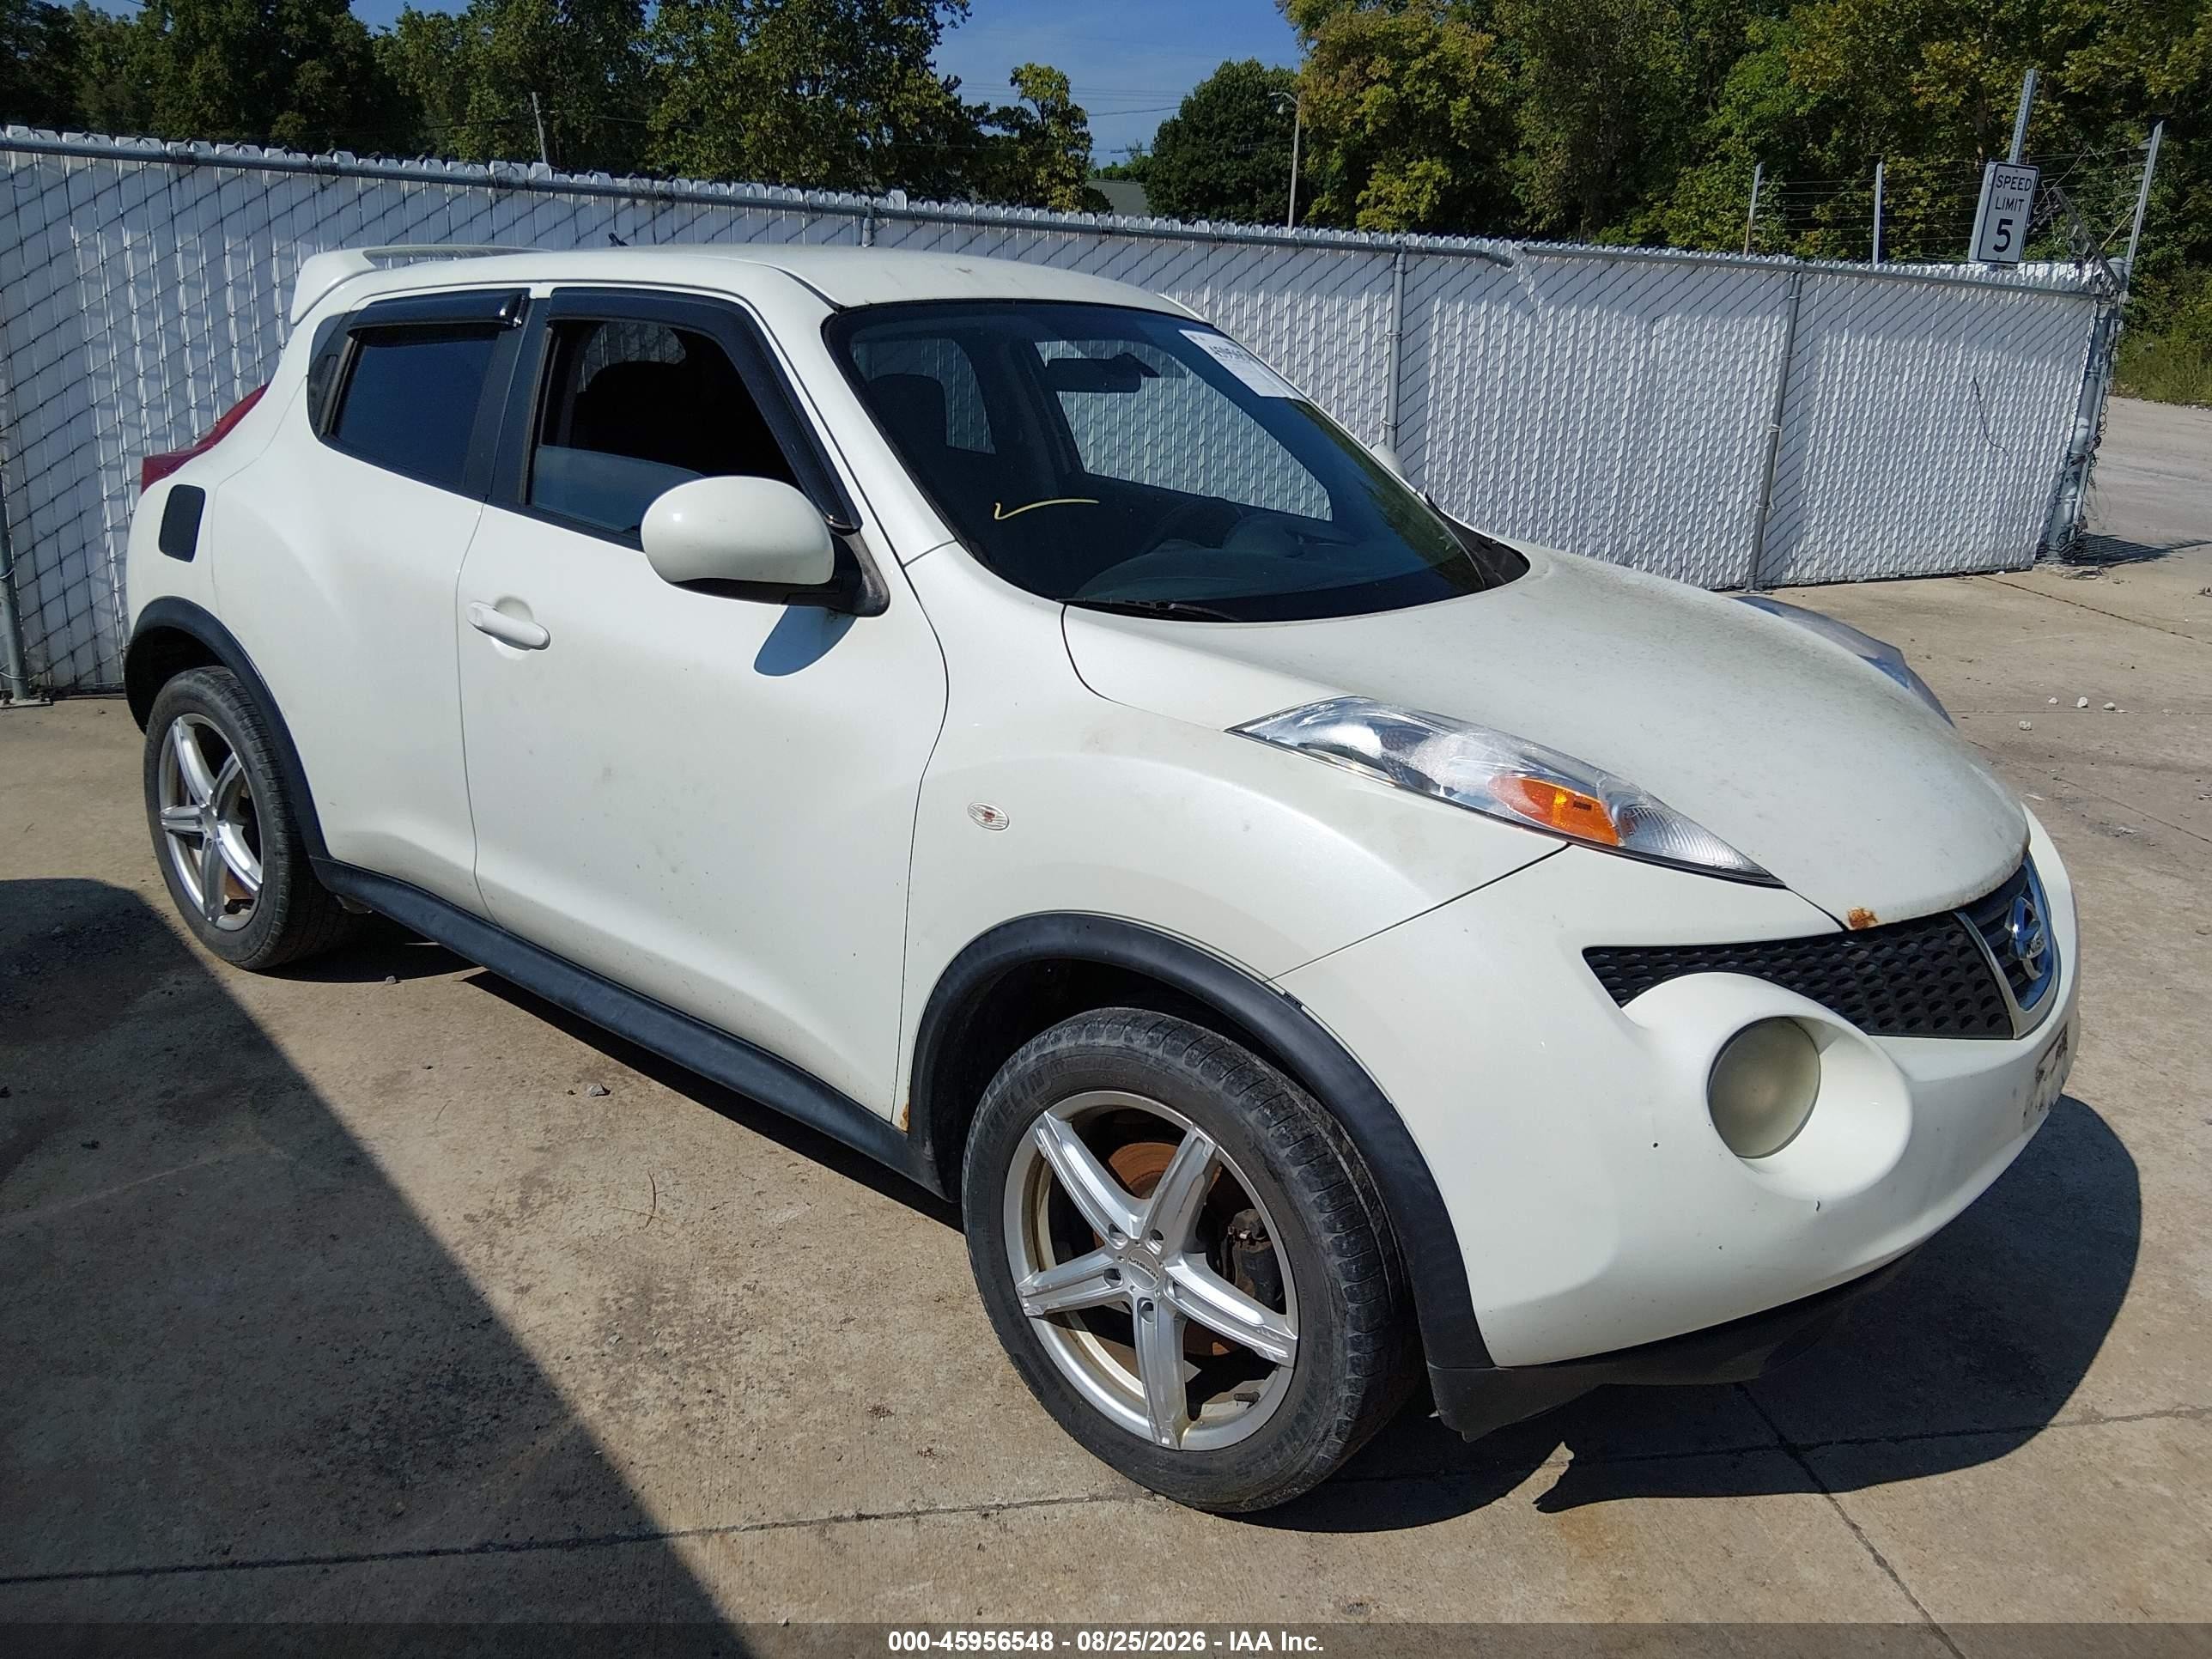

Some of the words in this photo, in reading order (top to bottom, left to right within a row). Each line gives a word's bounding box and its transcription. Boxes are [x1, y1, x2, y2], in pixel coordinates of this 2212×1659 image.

[1996, 174, 2033, 191] SPEED
[1995, 196, 2025, 212] LIMIT
[1992, 218, 2014, 252] 5
